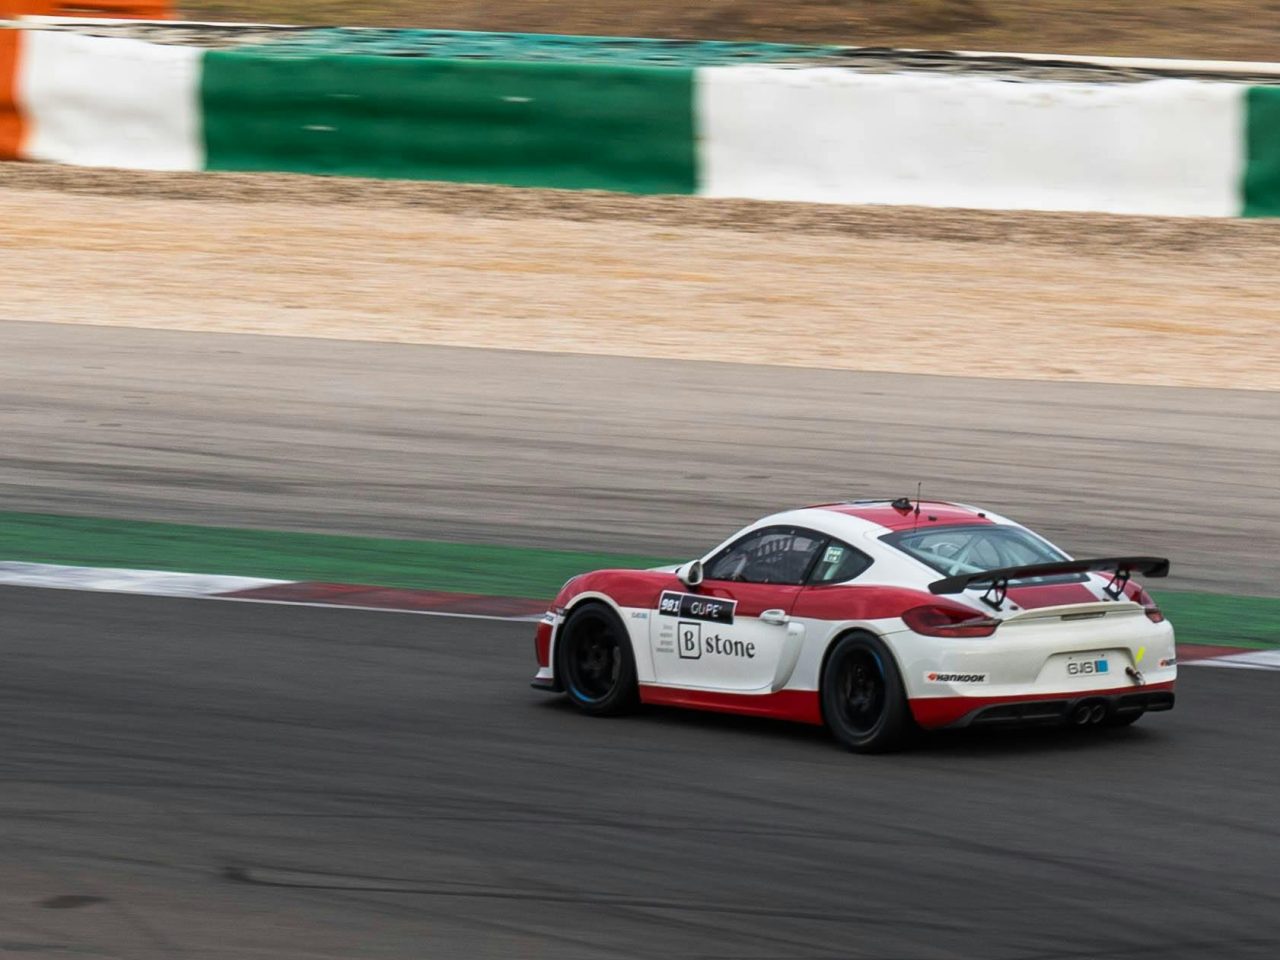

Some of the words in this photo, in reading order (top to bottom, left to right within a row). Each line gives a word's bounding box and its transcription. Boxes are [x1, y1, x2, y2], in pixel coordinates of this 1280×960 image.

[661, 598, 679, 612] 981
[684, 630, 695, 651] B
[705, 634, 755, 658] stone
